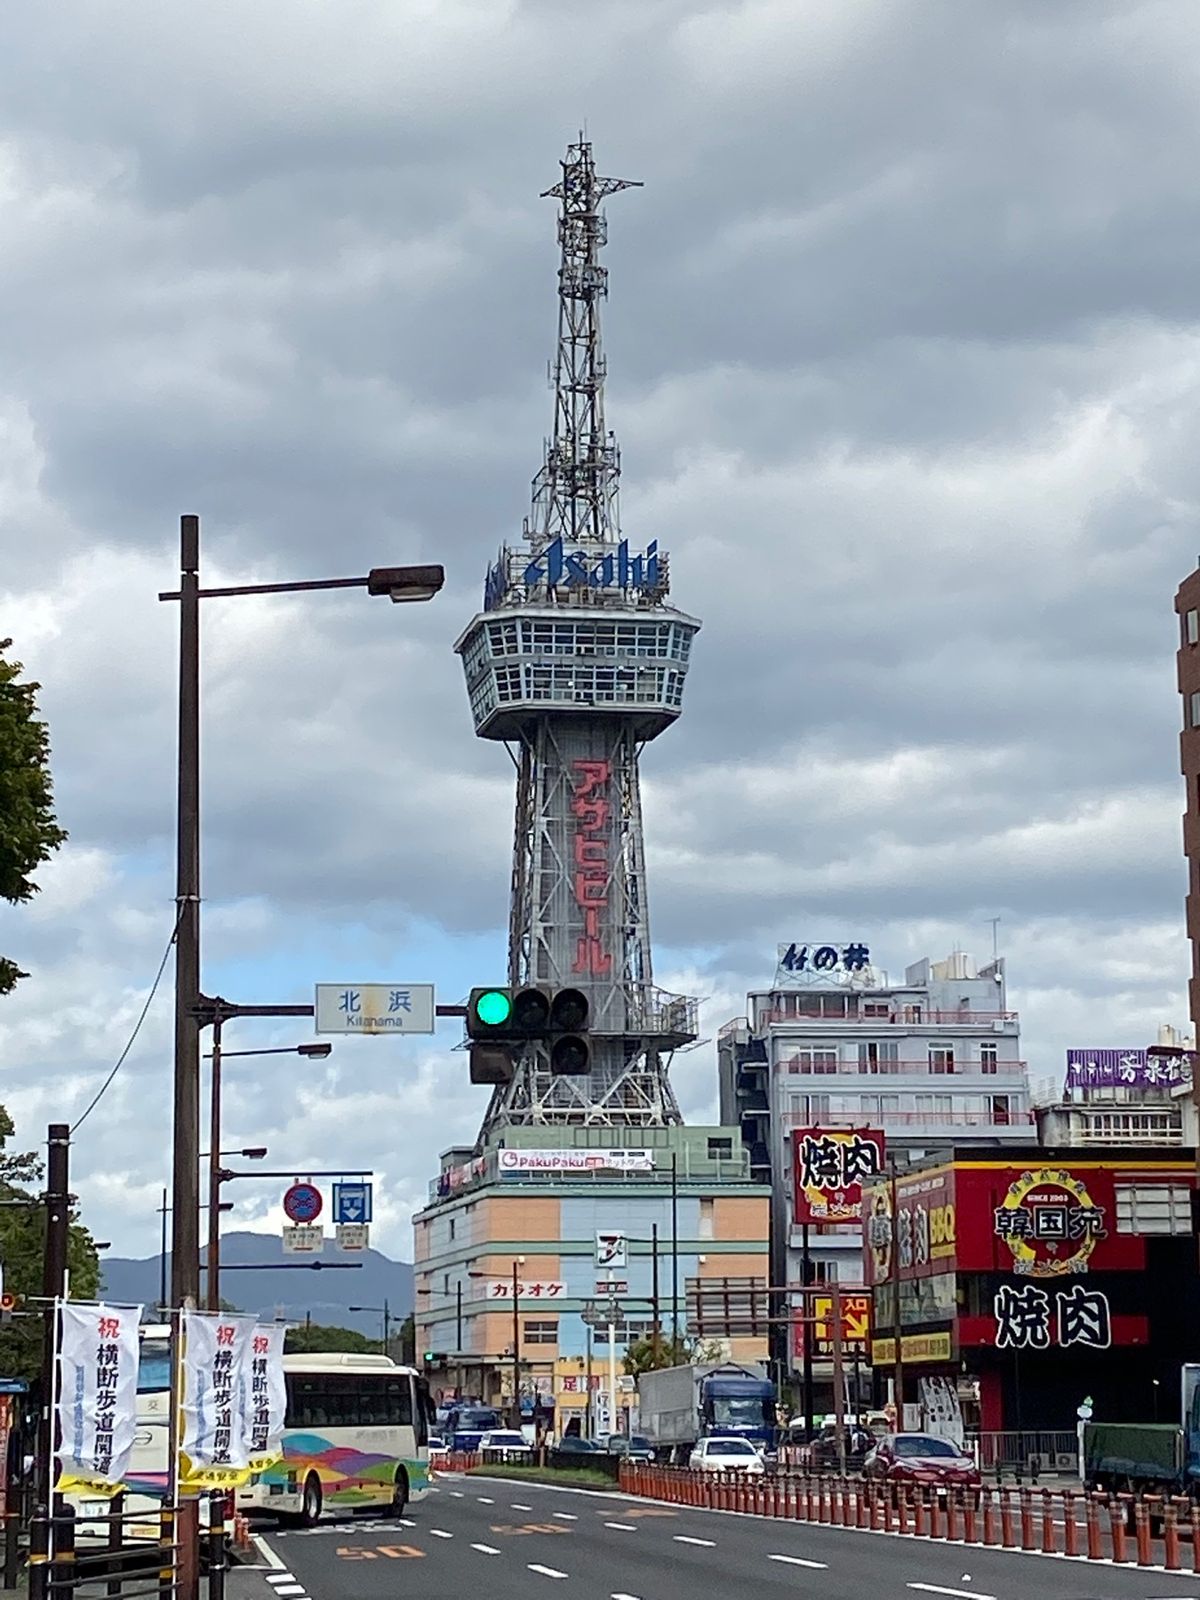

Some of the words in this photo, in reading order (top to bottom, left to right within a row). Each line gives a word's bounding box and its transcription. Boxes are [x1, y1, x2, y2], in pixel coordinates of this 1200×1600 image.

[524, 536, 658, 587] Asahi
[571, 759, 611, 974] アサヒビール
[339, 990, 411, 1012] 北浜
[800, 1134, 879, 1190] 焼肉
[930, 1204, 956, 1244] BBQ
[995, 1206, 1108, 1240] 韓国苑
[492, 1283, 563, 1297] カラオケ
[995, 1285, 1112, 1350] 焼肉
